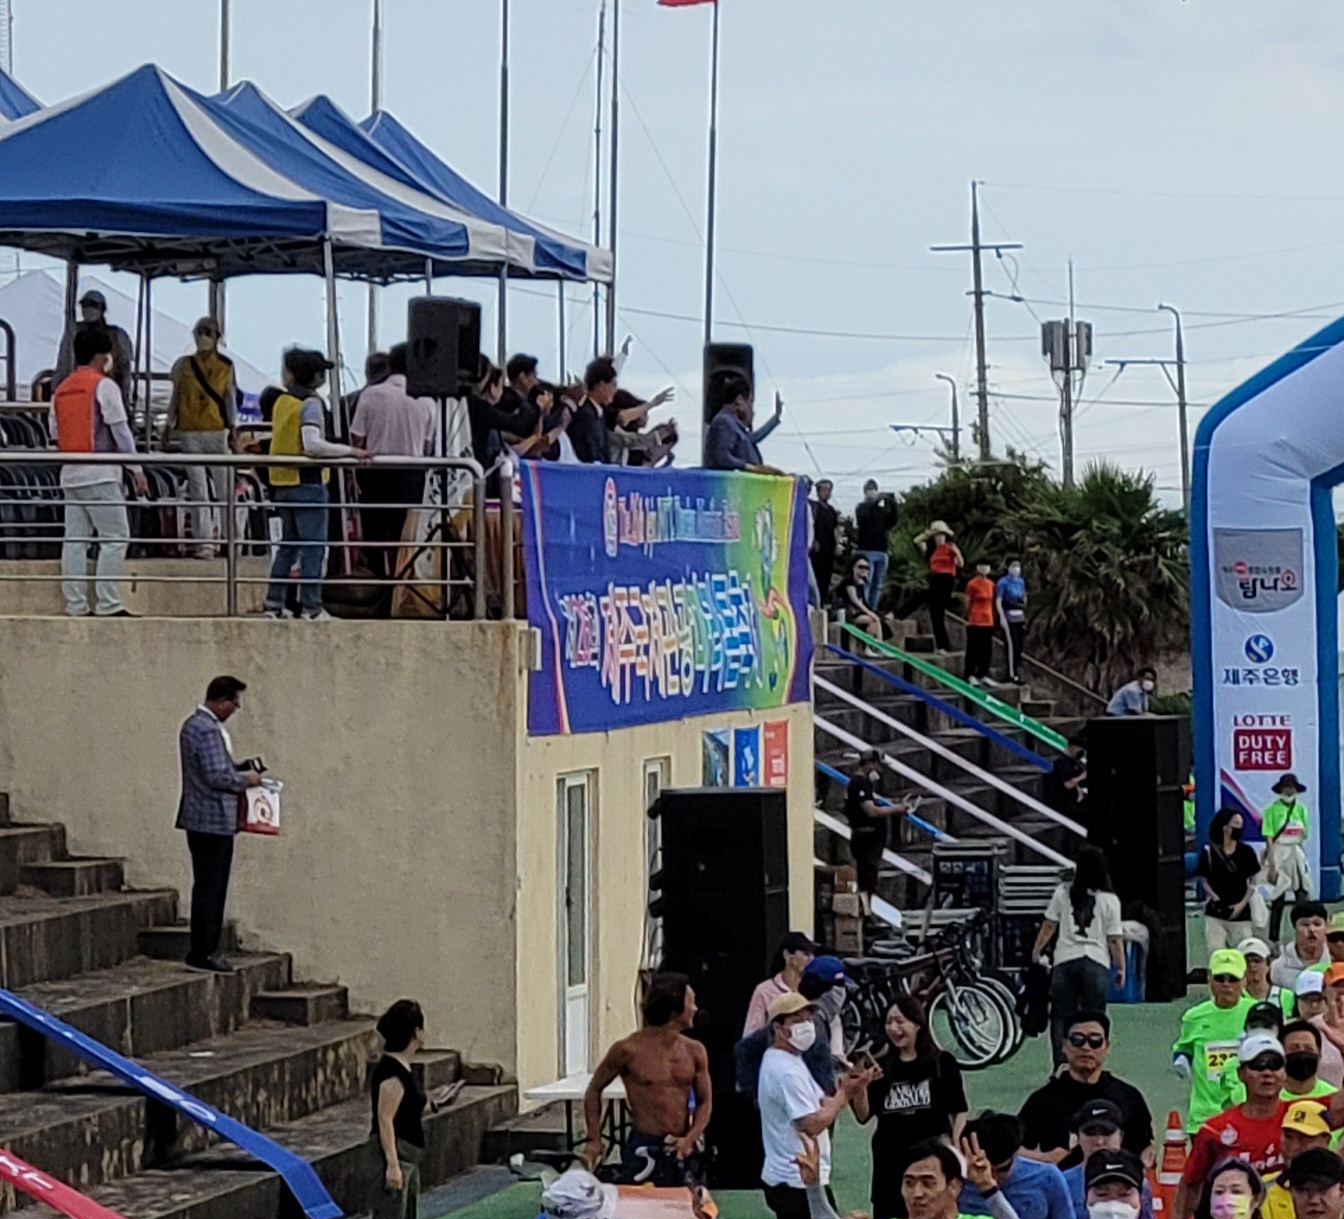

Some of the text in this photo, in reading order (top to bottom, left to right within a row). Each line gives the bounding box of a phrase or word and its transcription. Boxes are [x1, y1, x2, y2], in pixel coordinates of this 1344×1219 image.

[600, 570, 763, 704] 제주국제관광마라톤축제
[1223, 668, 1299, 686] 제주은행
[1234, 714, 1291, 727] LOTTE
[1238, 735, 1287, 749] DUTY
[1238, 751, 1287, 765] FREE
